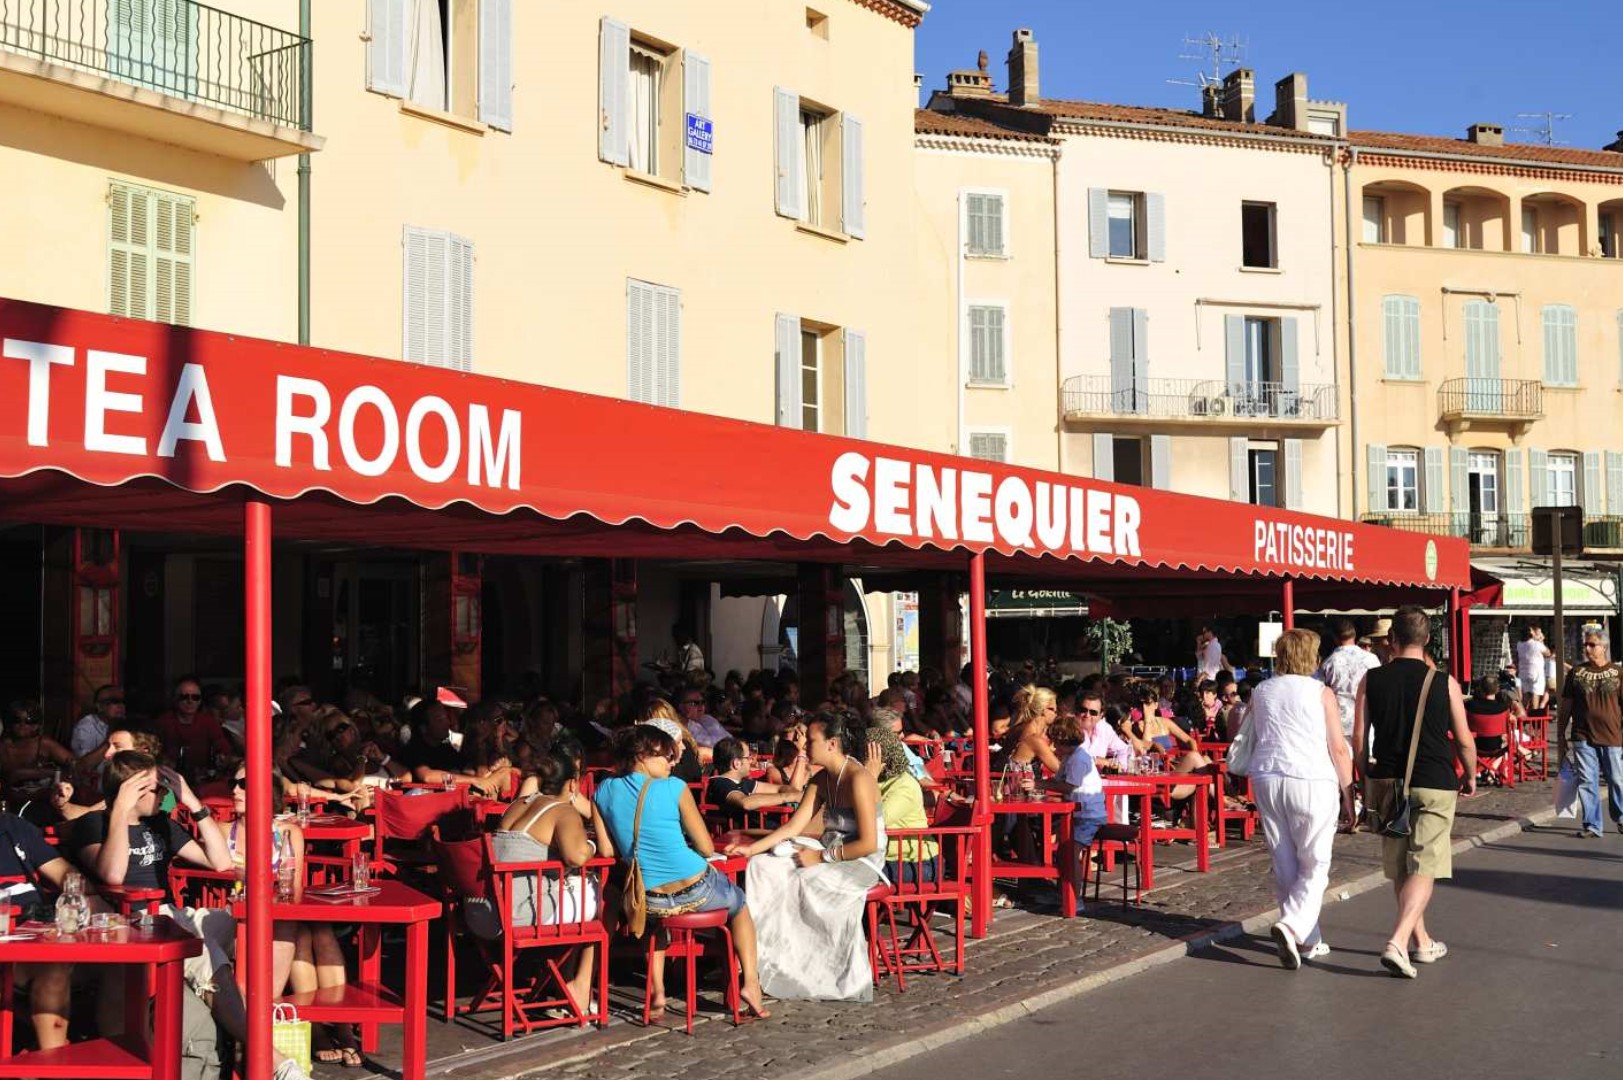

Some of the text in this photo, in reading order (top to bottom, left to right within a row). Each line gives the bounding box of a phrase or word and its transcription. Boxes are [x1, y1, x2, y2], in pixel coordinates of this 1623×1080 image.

[688, 126, 712, 142] GALLERY
[3, 338, 522, 491] TEA ROOM
[829, 452, 1142, 560] SENEQUIER
[1254, 520, 1355, 572] PATISSERIE
